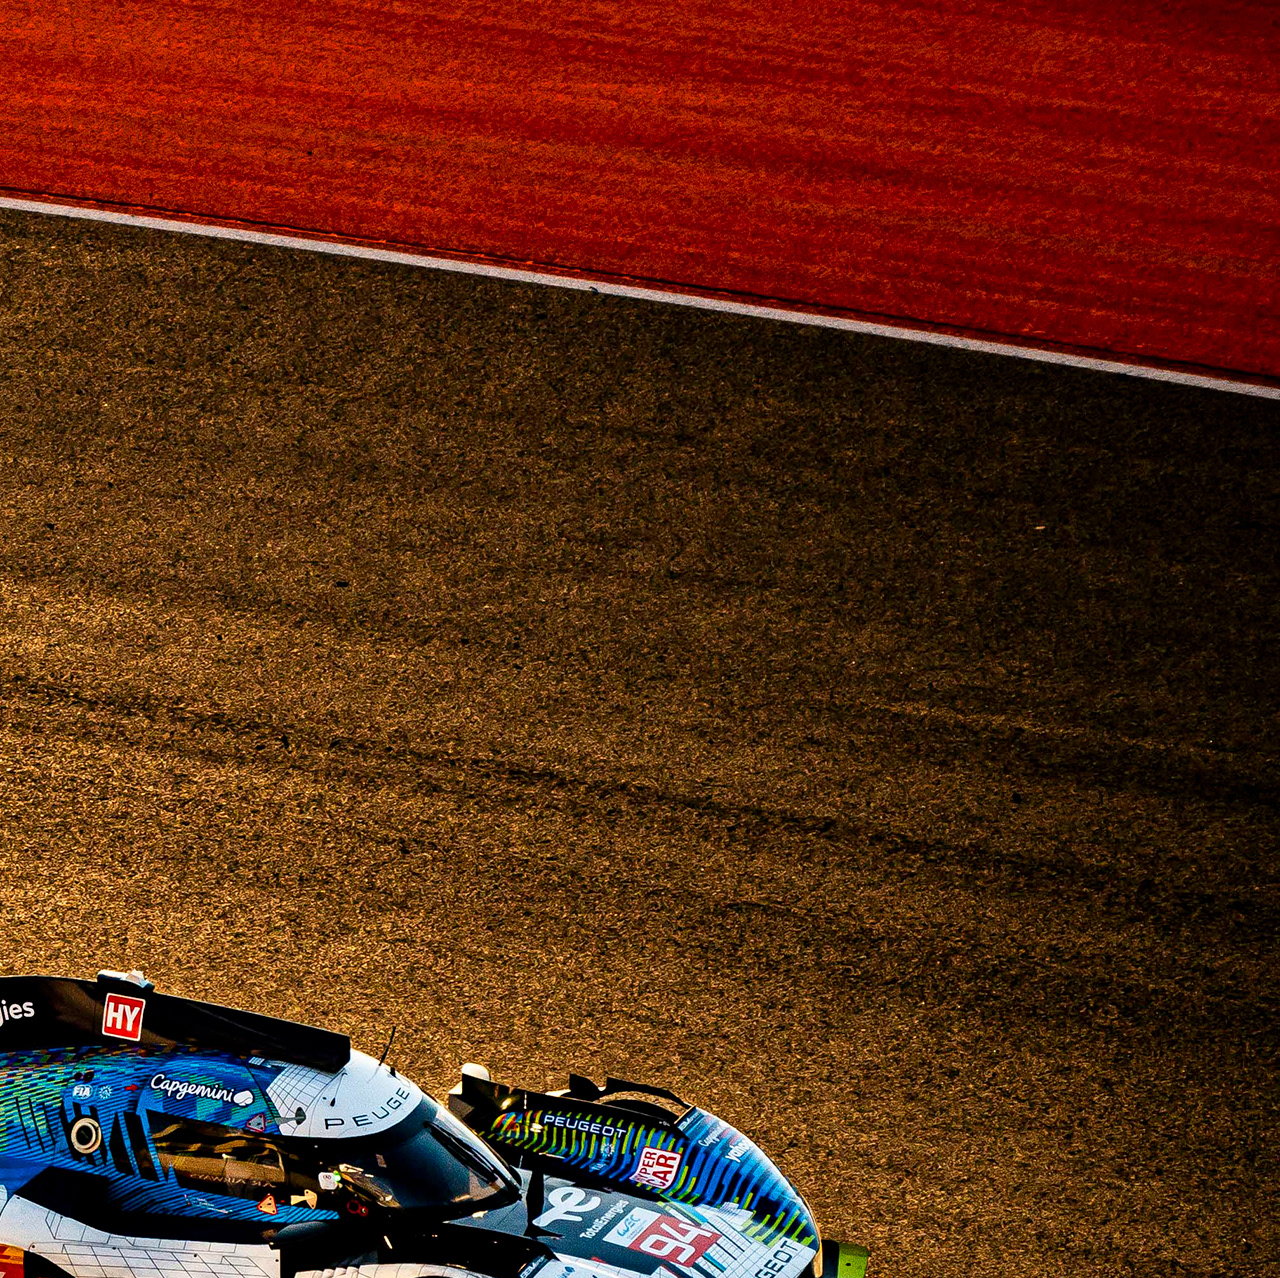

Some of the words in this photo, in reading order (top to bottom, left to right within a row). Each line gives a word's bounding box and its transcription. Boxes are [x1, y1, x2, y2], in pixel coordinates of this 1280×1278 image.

[106, 1002, 140, 1031] HY
[150, 1073, 233, 1102] Capgemini
[324, 1087, 410, 1130] PEUGE
[544, 1115, 626, 1138] PEUGEOT
[579, 1200, 629, 1239] TotalEnergies
[639, 1222, 712, 1264] 94
